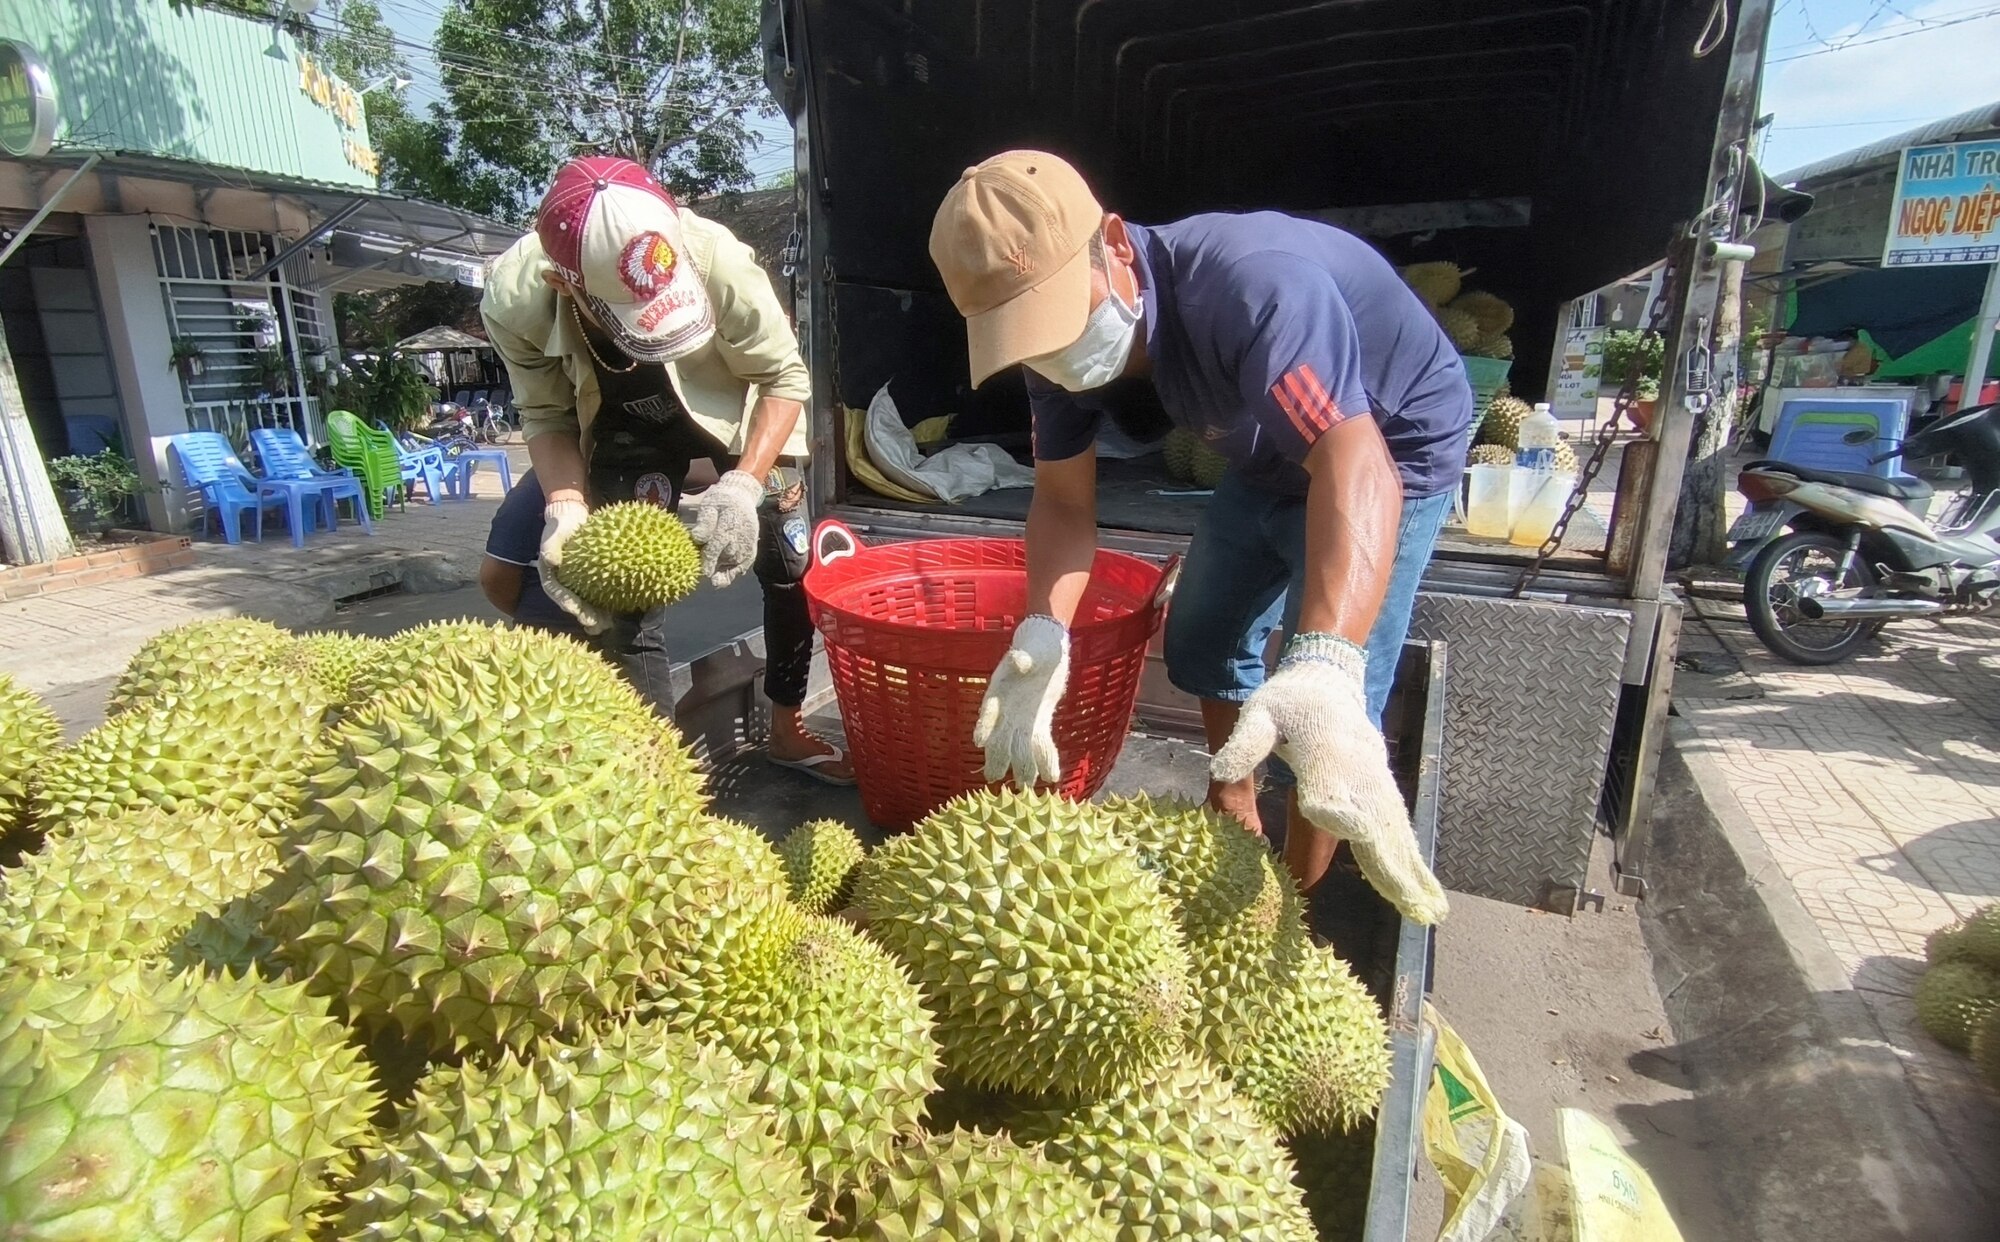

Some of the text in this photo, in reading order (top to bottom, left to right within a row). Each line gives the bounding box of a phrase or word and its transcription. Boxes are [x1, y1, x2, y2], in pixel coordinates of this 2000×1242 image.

[1908, 146, 2000, 180] NHÀ TR
[1897, 196, 1953, 243] NGỌC
